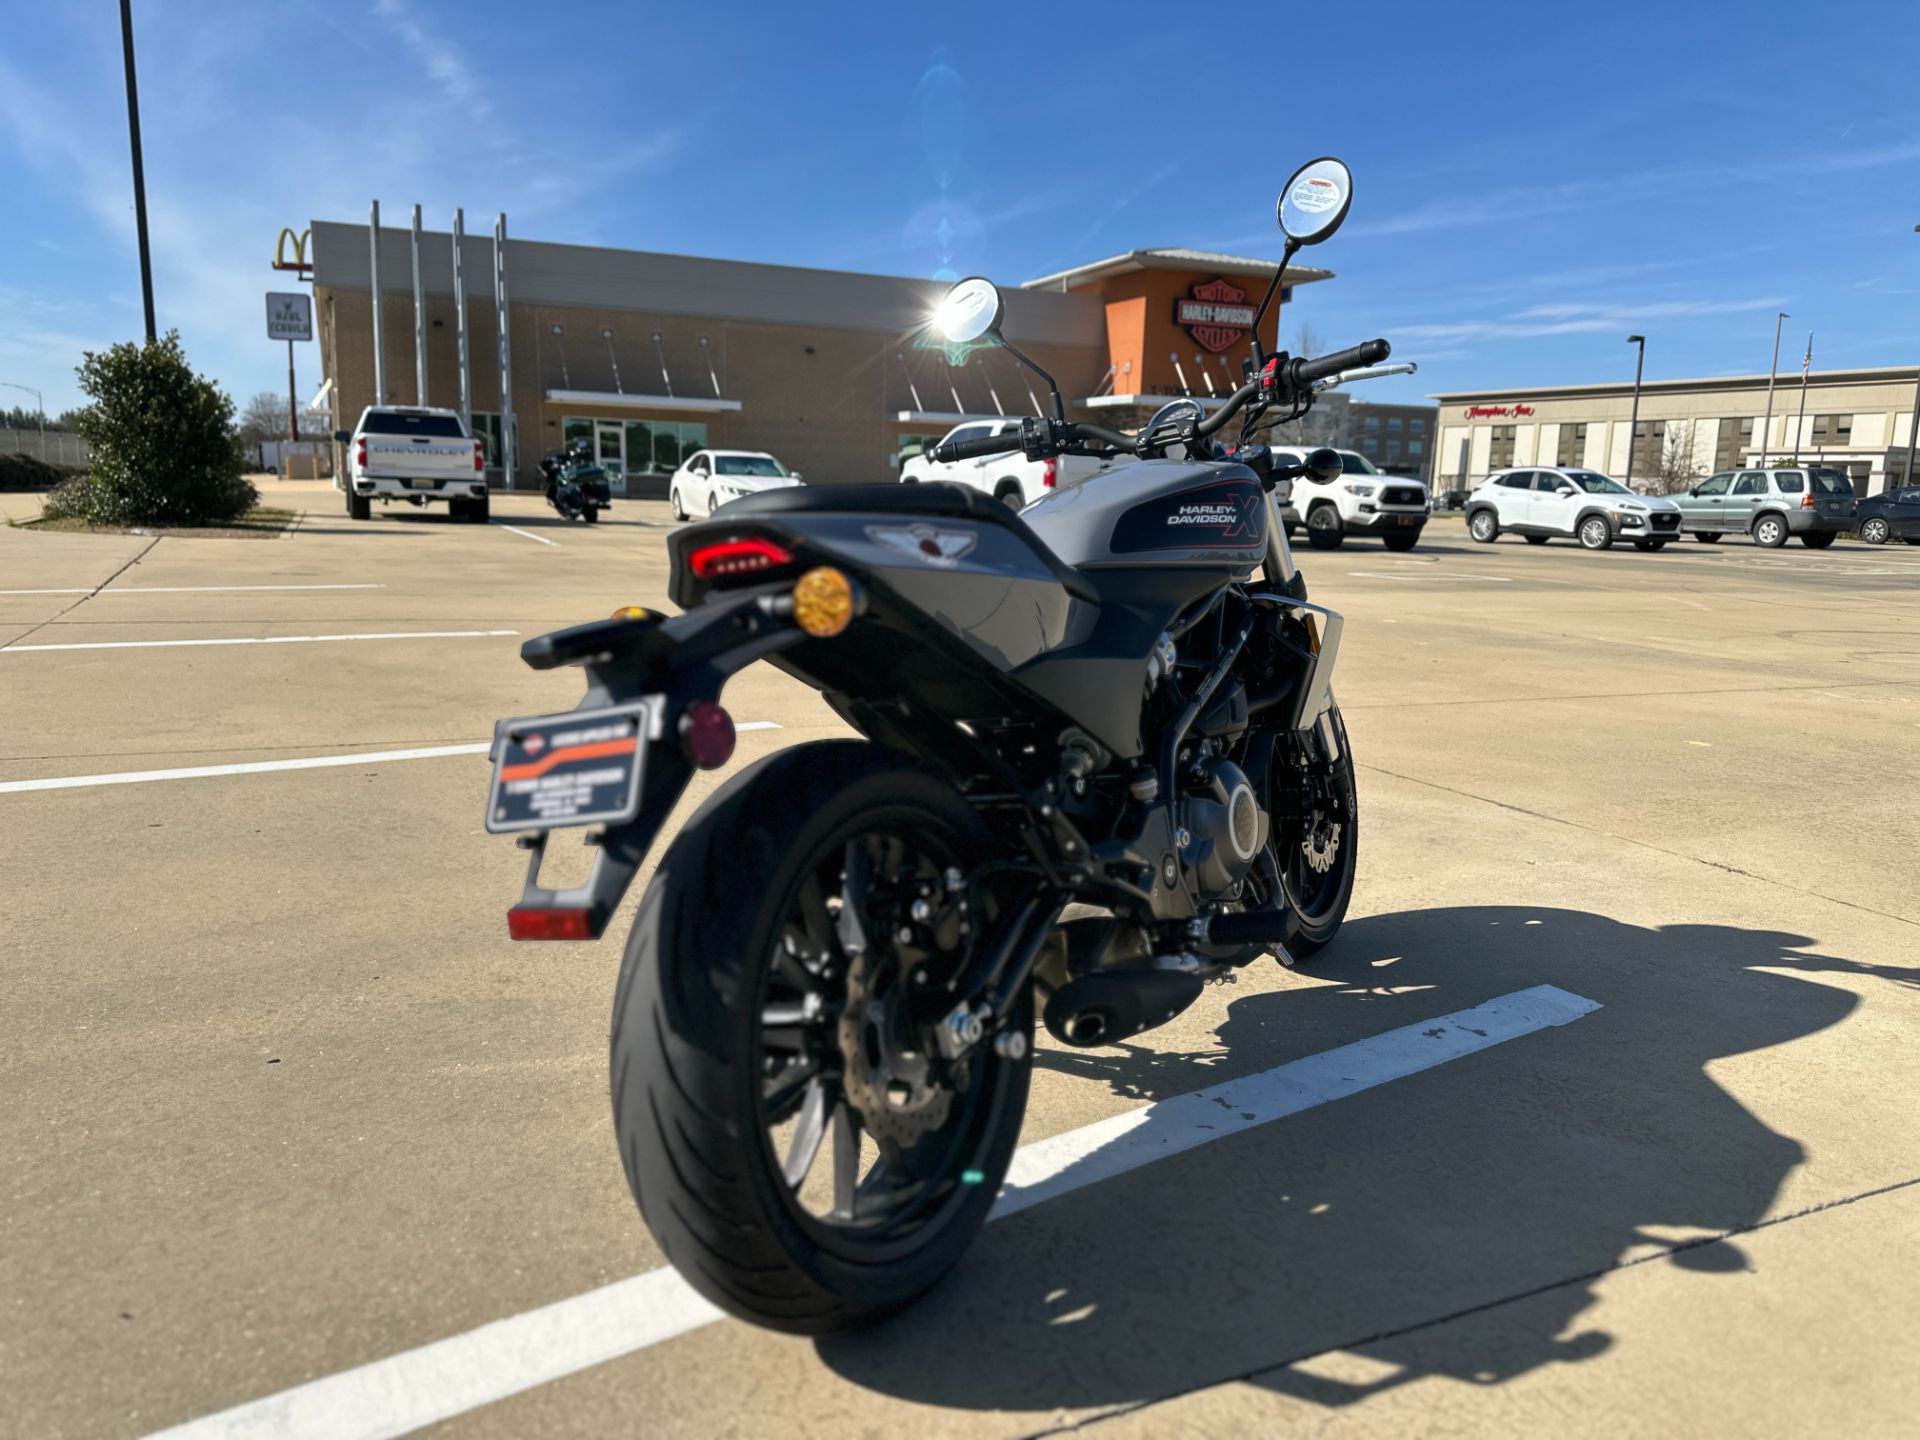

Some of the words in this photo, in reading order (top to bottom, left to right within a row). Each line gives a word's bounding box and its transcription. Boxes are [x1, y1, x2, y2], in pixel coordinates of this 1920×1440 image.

[1199, 286, 1240, 302] MOTOR
[1182, 303, 1254, 325] HARLEY-DAVIDSON
[1198, 327, 1239, 346] CYCLES
[1465, 405, 1510, 420] Hampton
[1511, 404, 1534, 418] Inn
[373, 447, 466, 457] CHEVROLET
[1180, 505, 1236, 514] HARLEY-
[1167, 514, 1237, 525] DAVIDSON
